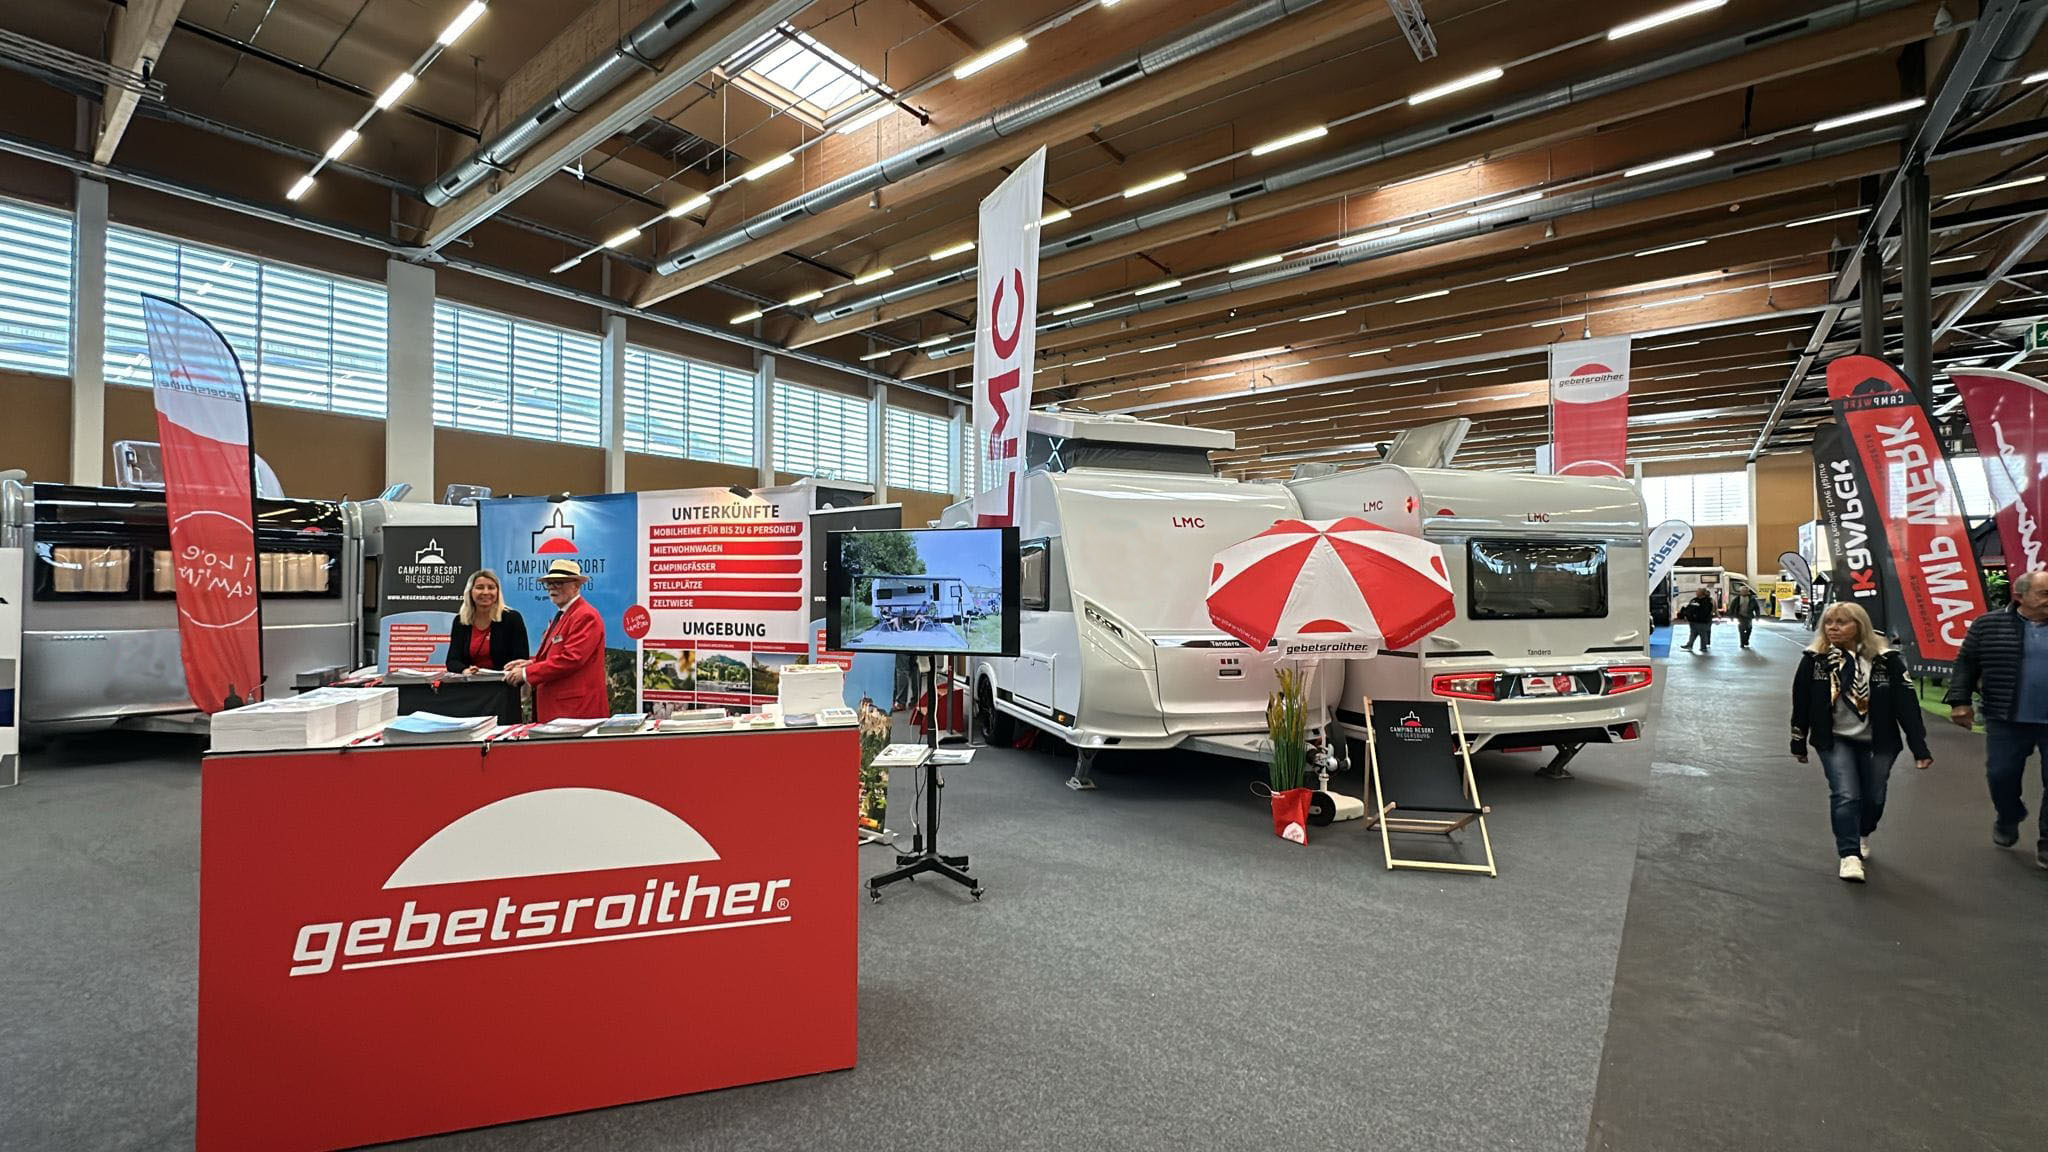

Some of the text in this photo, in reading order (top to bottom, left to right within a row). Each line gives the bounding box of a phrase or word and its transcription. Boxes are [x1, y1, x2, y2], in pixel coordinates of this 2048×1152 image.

[1558, 373, 1625, 388] gebetsroither
[976, 267, 1025, 528] LMC
[672, 502, 780, 520] UNTERKÜNFTE
[1362, 500, 1384, 513] LMC
[1172, 516, 1205, 529] LMC
[1527, 512, 1550, 523] LMC
[653, 524, 796, 537] MOBILHEIME FÜR BIS ZU 6 PERSONEN
[653, 544, 723, 554] MIETWOHNWAGEN
[398, 566, 462, 575] CAMPING RESORT
[506, 558, 606, 575] CAMPIN SORT
[653, 561, 716, 572] CAMPINGFÄSSER
[405, 575, 455, 584] RIEGERSBURG
[653, 579, 703, 590] STELLPLÄTZE
[653, 599, 693, 608] ZELTWIESE
[682, 621, 766, 637] UMGEBUNG
[1209, 639, 1240, 648] Tandero
[1286, 642, 1369, 655] gebetsroither
[1527, 648, 1552, 656] Tandero
